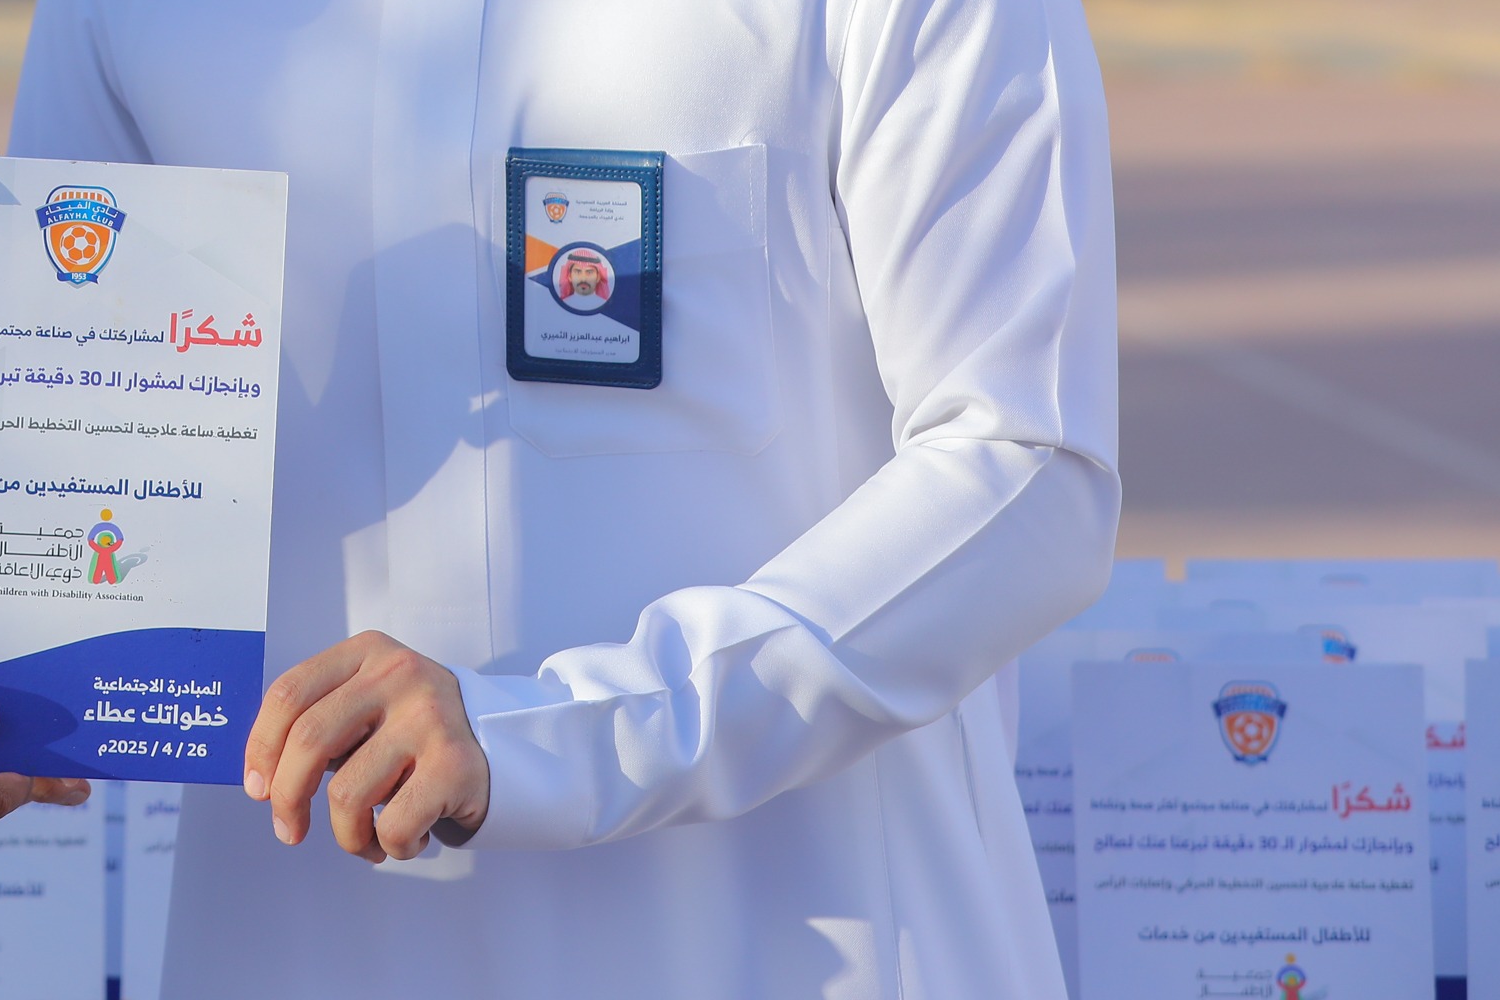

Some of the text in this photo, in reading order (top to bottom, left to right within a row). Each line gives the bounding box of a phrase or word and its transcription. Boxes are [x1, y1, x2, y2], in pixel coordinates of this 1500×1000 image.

[46, 201, 90, 215] الفيحاء
[48, 213, 114, 227] ALFAYHA CLUB
[35, 324, 72, 339] صناعة
[76, 329, 95, 347] في
[99, 327, 164, 344] لمشاركتك
[170, 309, 262, 352] شكرًا
[24, 366, 74, 389] دقيقة
[79, 370, 101, 387] 30
[124, 372, 185, 393] لمشوار
[188, 373, 261, 399] وبإنجازك
[28, 417, 82, 432] التخطيط
[84, 421, 134, 436] لتحسين
[136, 422, 178, 438] علاجية
[180, 425, 215, 438] ساعة
[215, 426, 258, 441] تغطية
[25, 476, 129, 498] المستفيدين
[133, 479, 202, 500] للأطفال
[47, 567, 82, 583] ذوي
[30, 589, 49, 598] with
[52, 589, 93, 600] Disability
[95, 592, 144, 602] Association
[94, 676, 222, 698] المبادرة الاجتماعية
[84, 701, 228, 731] خطواتك عطاء
[98, 740, 207, 758] 26 / 4 / 2025م
